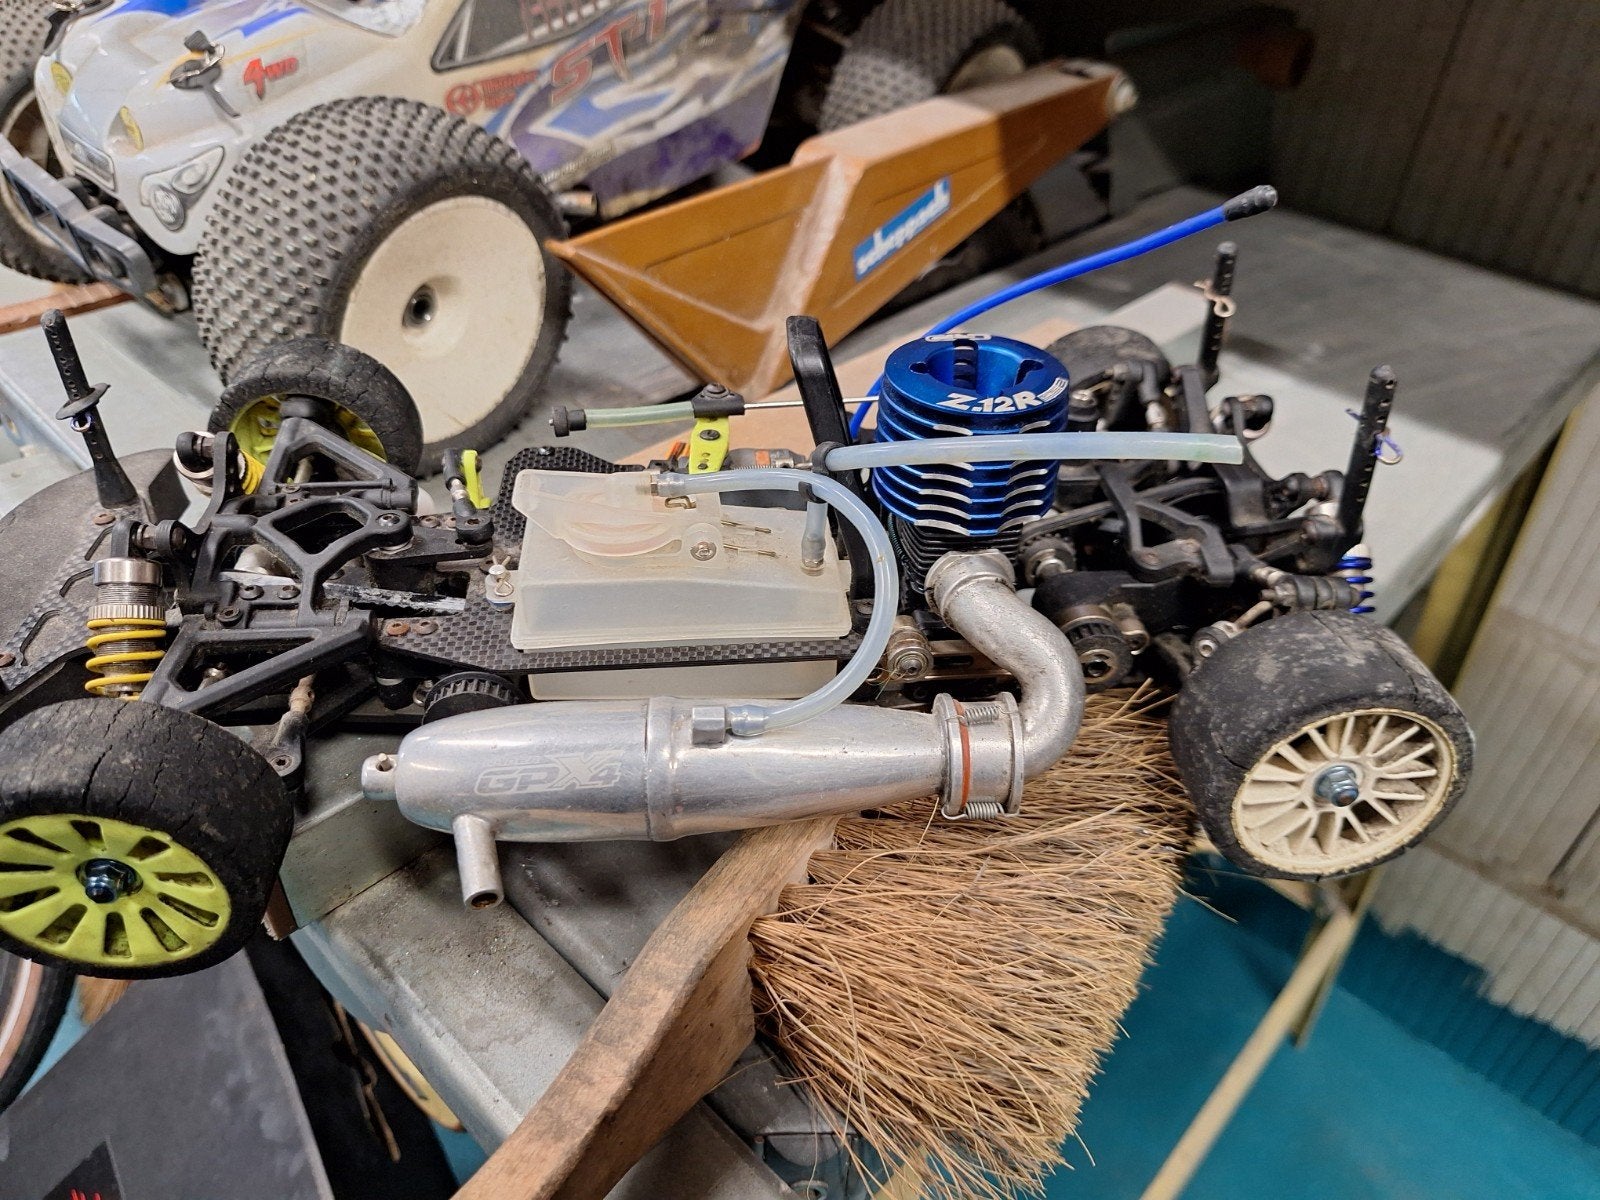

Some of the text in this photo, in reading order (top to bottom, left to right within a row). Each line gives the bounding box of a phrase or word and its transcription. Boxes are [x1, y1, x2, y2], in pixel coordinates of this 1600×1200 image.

[244, 58, 299, 100] 4WD
[936, 391, 1042, 412] Z.12R
[475, 750, 624, 796] GPX4
